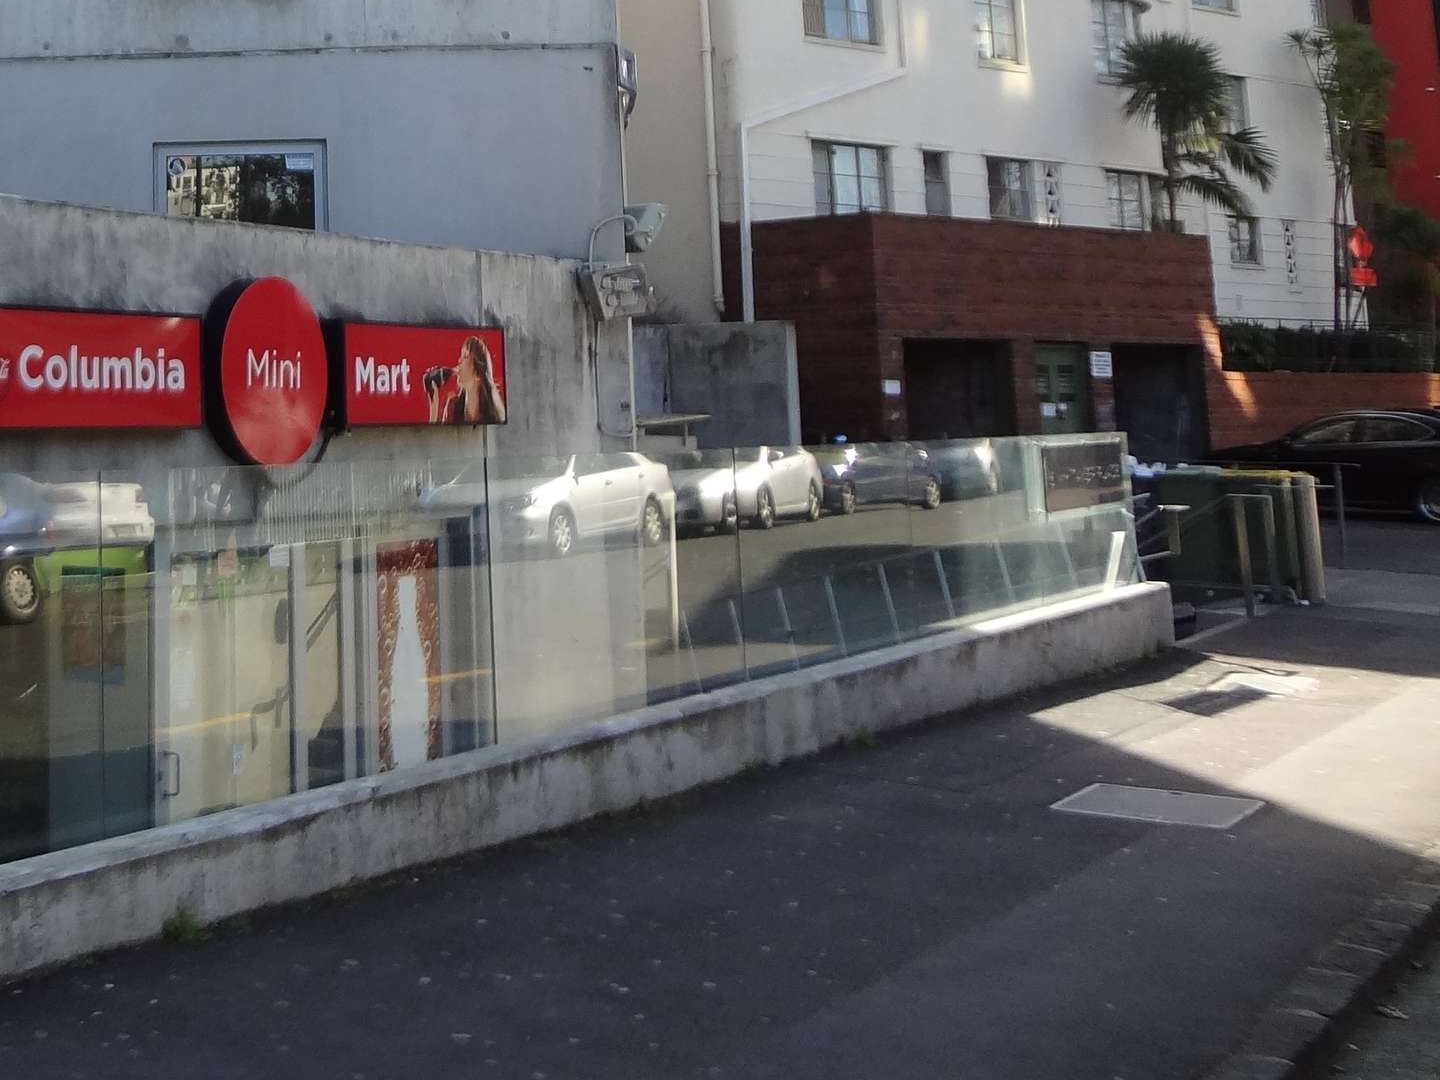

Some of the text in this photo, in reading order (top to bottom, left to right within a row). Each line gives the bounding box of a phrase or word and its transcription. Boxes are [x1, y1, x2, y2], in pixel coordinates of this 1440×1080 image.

[18, 344, 411, 393] Columbia Mini Mart
